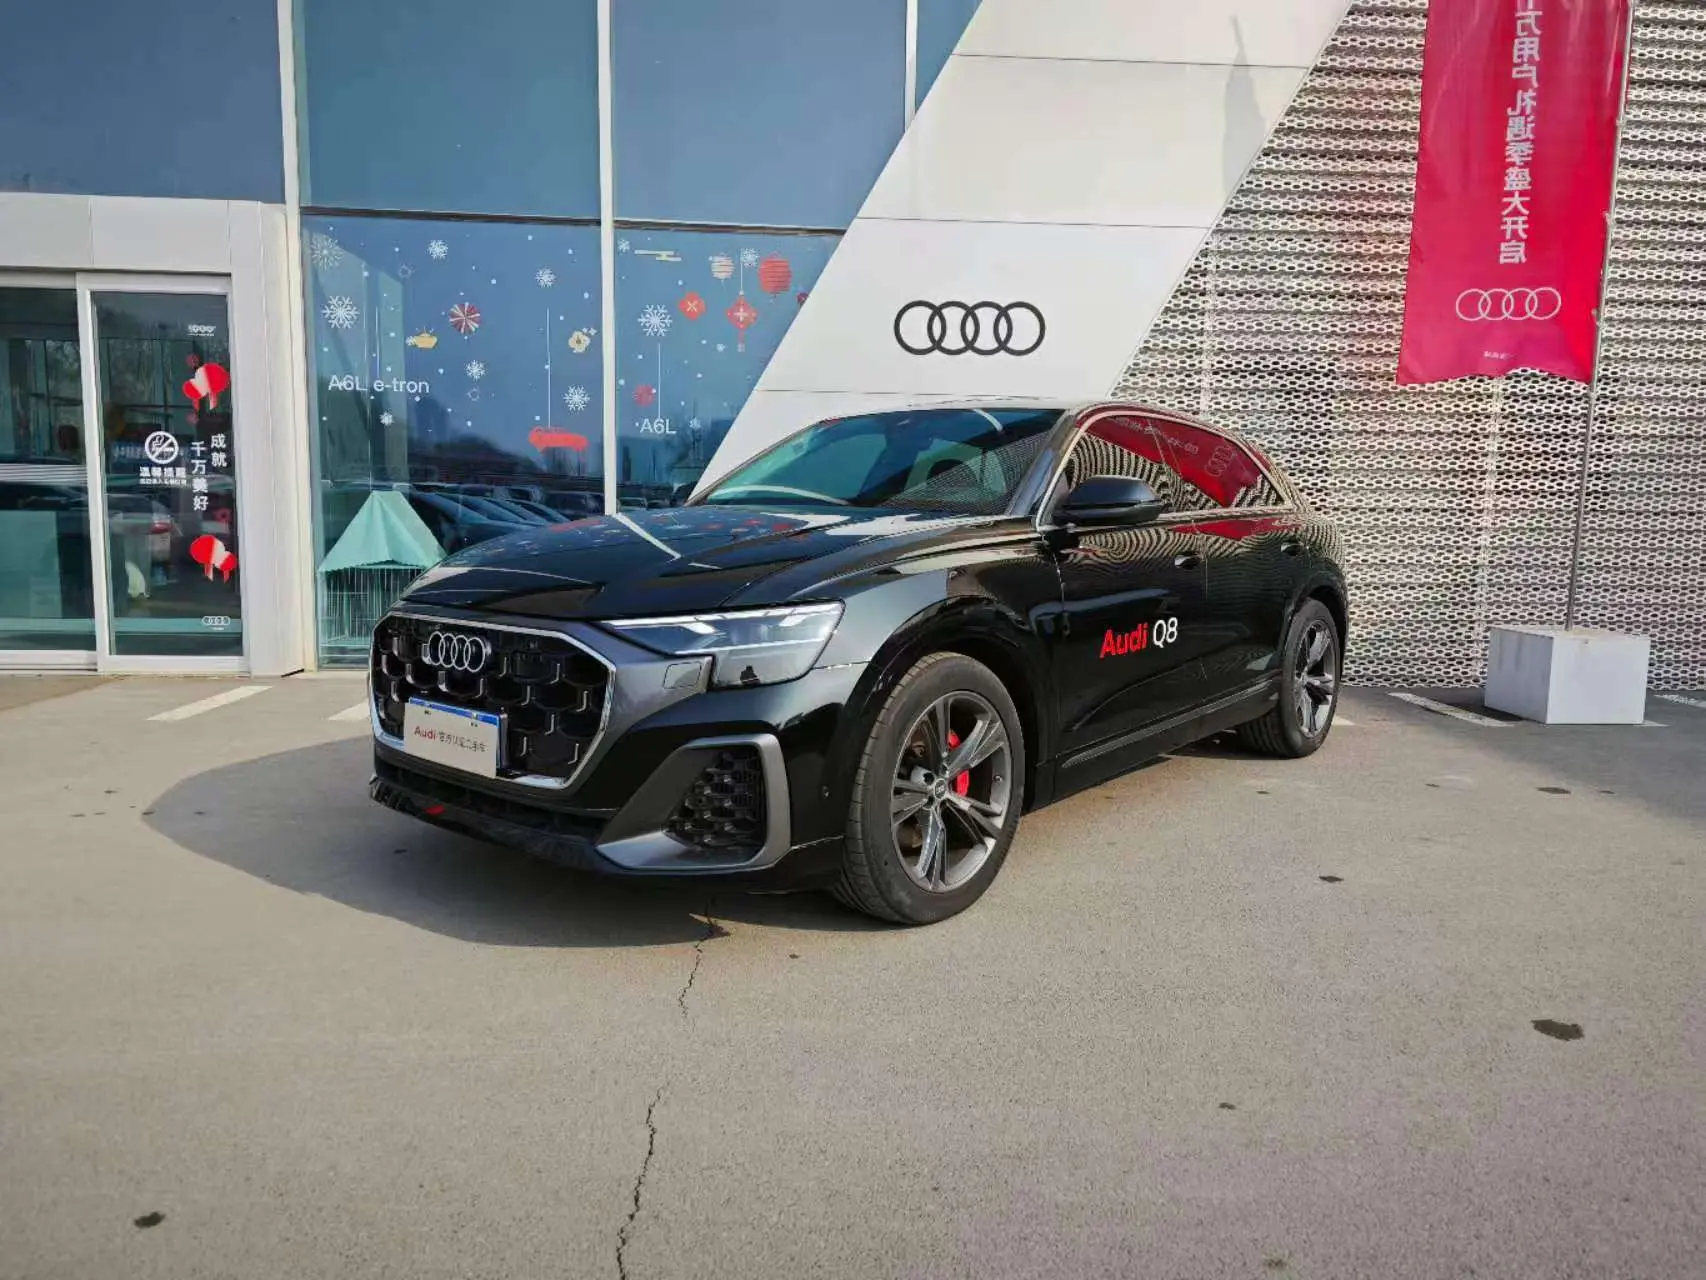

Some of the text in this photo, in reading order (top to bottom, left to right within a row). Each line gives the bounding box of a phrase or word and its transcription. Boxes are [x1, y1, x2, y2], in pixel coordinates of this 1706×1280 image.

[328, 374, 430, 393] A6L e-tron
[640, 418, 677, 434] A6L
[211, 433, 227, 467] 成就
[191, 441, 209, 511] 千万美好
[1099, 617, 1178, 658] Audi Q8
[414, 725, 436, 741] Audi
